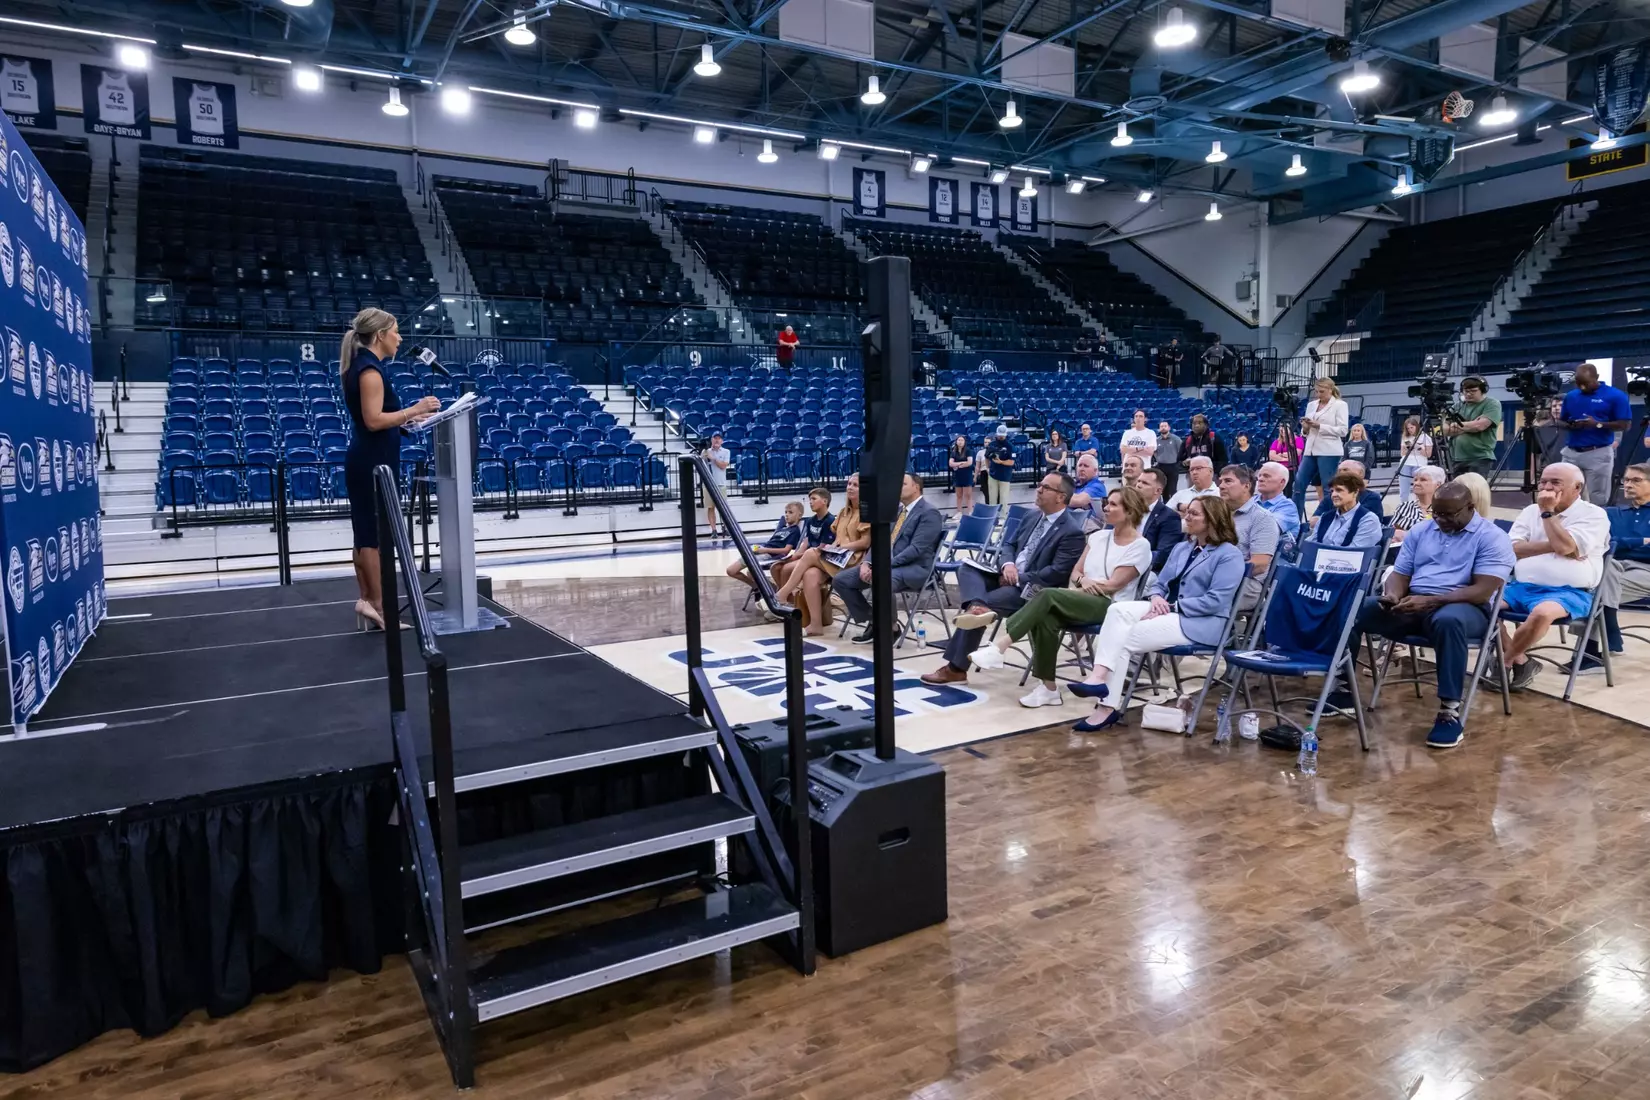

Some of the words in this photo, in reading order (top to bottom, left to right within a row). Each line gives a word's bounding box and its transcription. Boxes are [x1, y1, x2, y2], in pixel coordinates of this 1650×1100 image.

[12, 79, 25, 92] 15
[108, 92, 124, 104] 42
[199, 103, 213, 114] 50
[192, 135, 224, 146] ROBERTS
[1590, 149, 1622, 165] STATE
[301, 343, 315, 361] 8
[689, 350, 702, 367] 9
[1297, 583, 1331, 602] HAJEN
